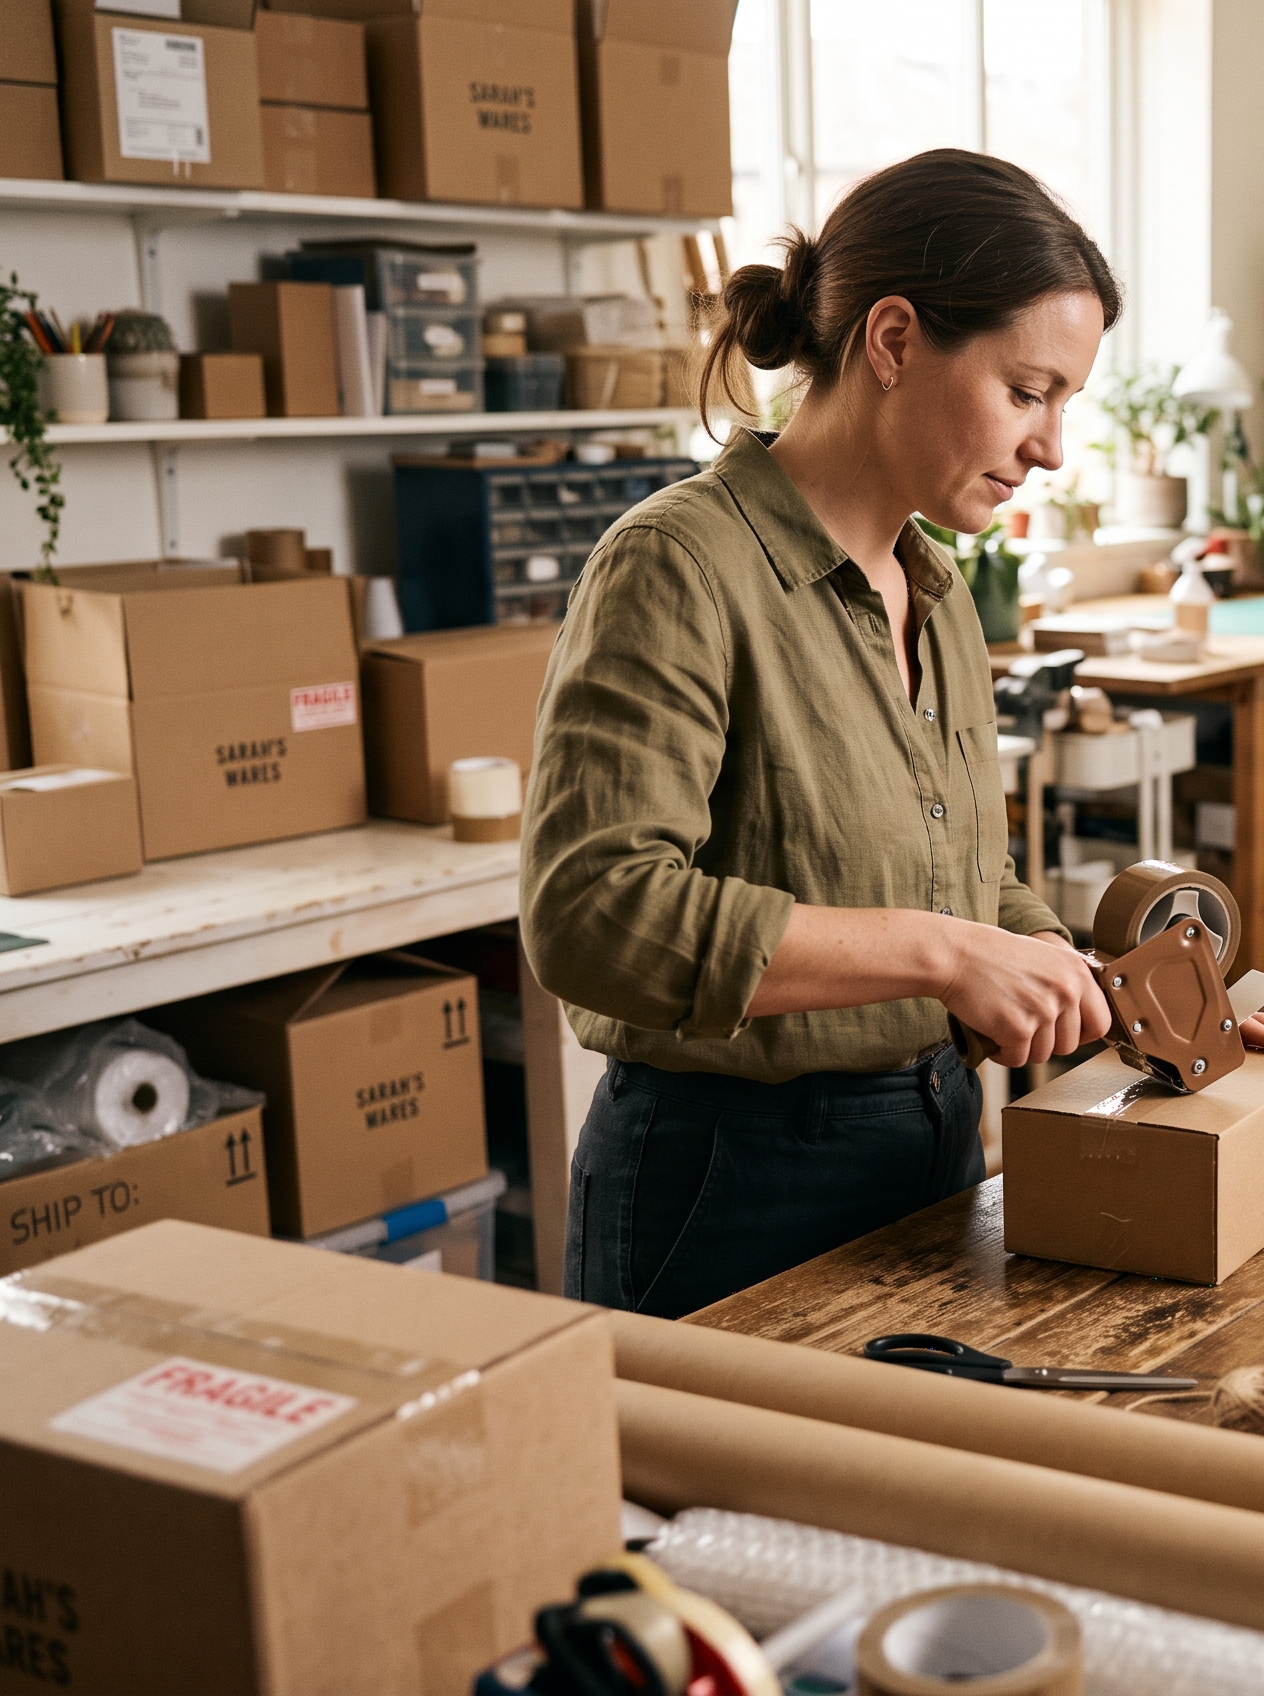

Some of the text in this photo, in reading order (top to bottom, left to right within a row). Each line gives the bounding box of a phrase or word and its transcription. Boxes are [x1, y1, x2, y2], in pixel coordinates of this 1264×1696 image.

[469, 81, 536, 109] SARAH'S
[477, 109, 531, 134] WARES
[294, 687, 352, 706] FRAGILE
[215, 737, 286, 765] SARAH'S
[225, 761, 281, 787] WARES
[356, 1071, 425, 1109] SARAH'S
[365, 1096, 420, 1129] WARES
[10, 1181, 139, 1246] SHIP TO:
[139, 1365, 336, 1426] FRAGILE
